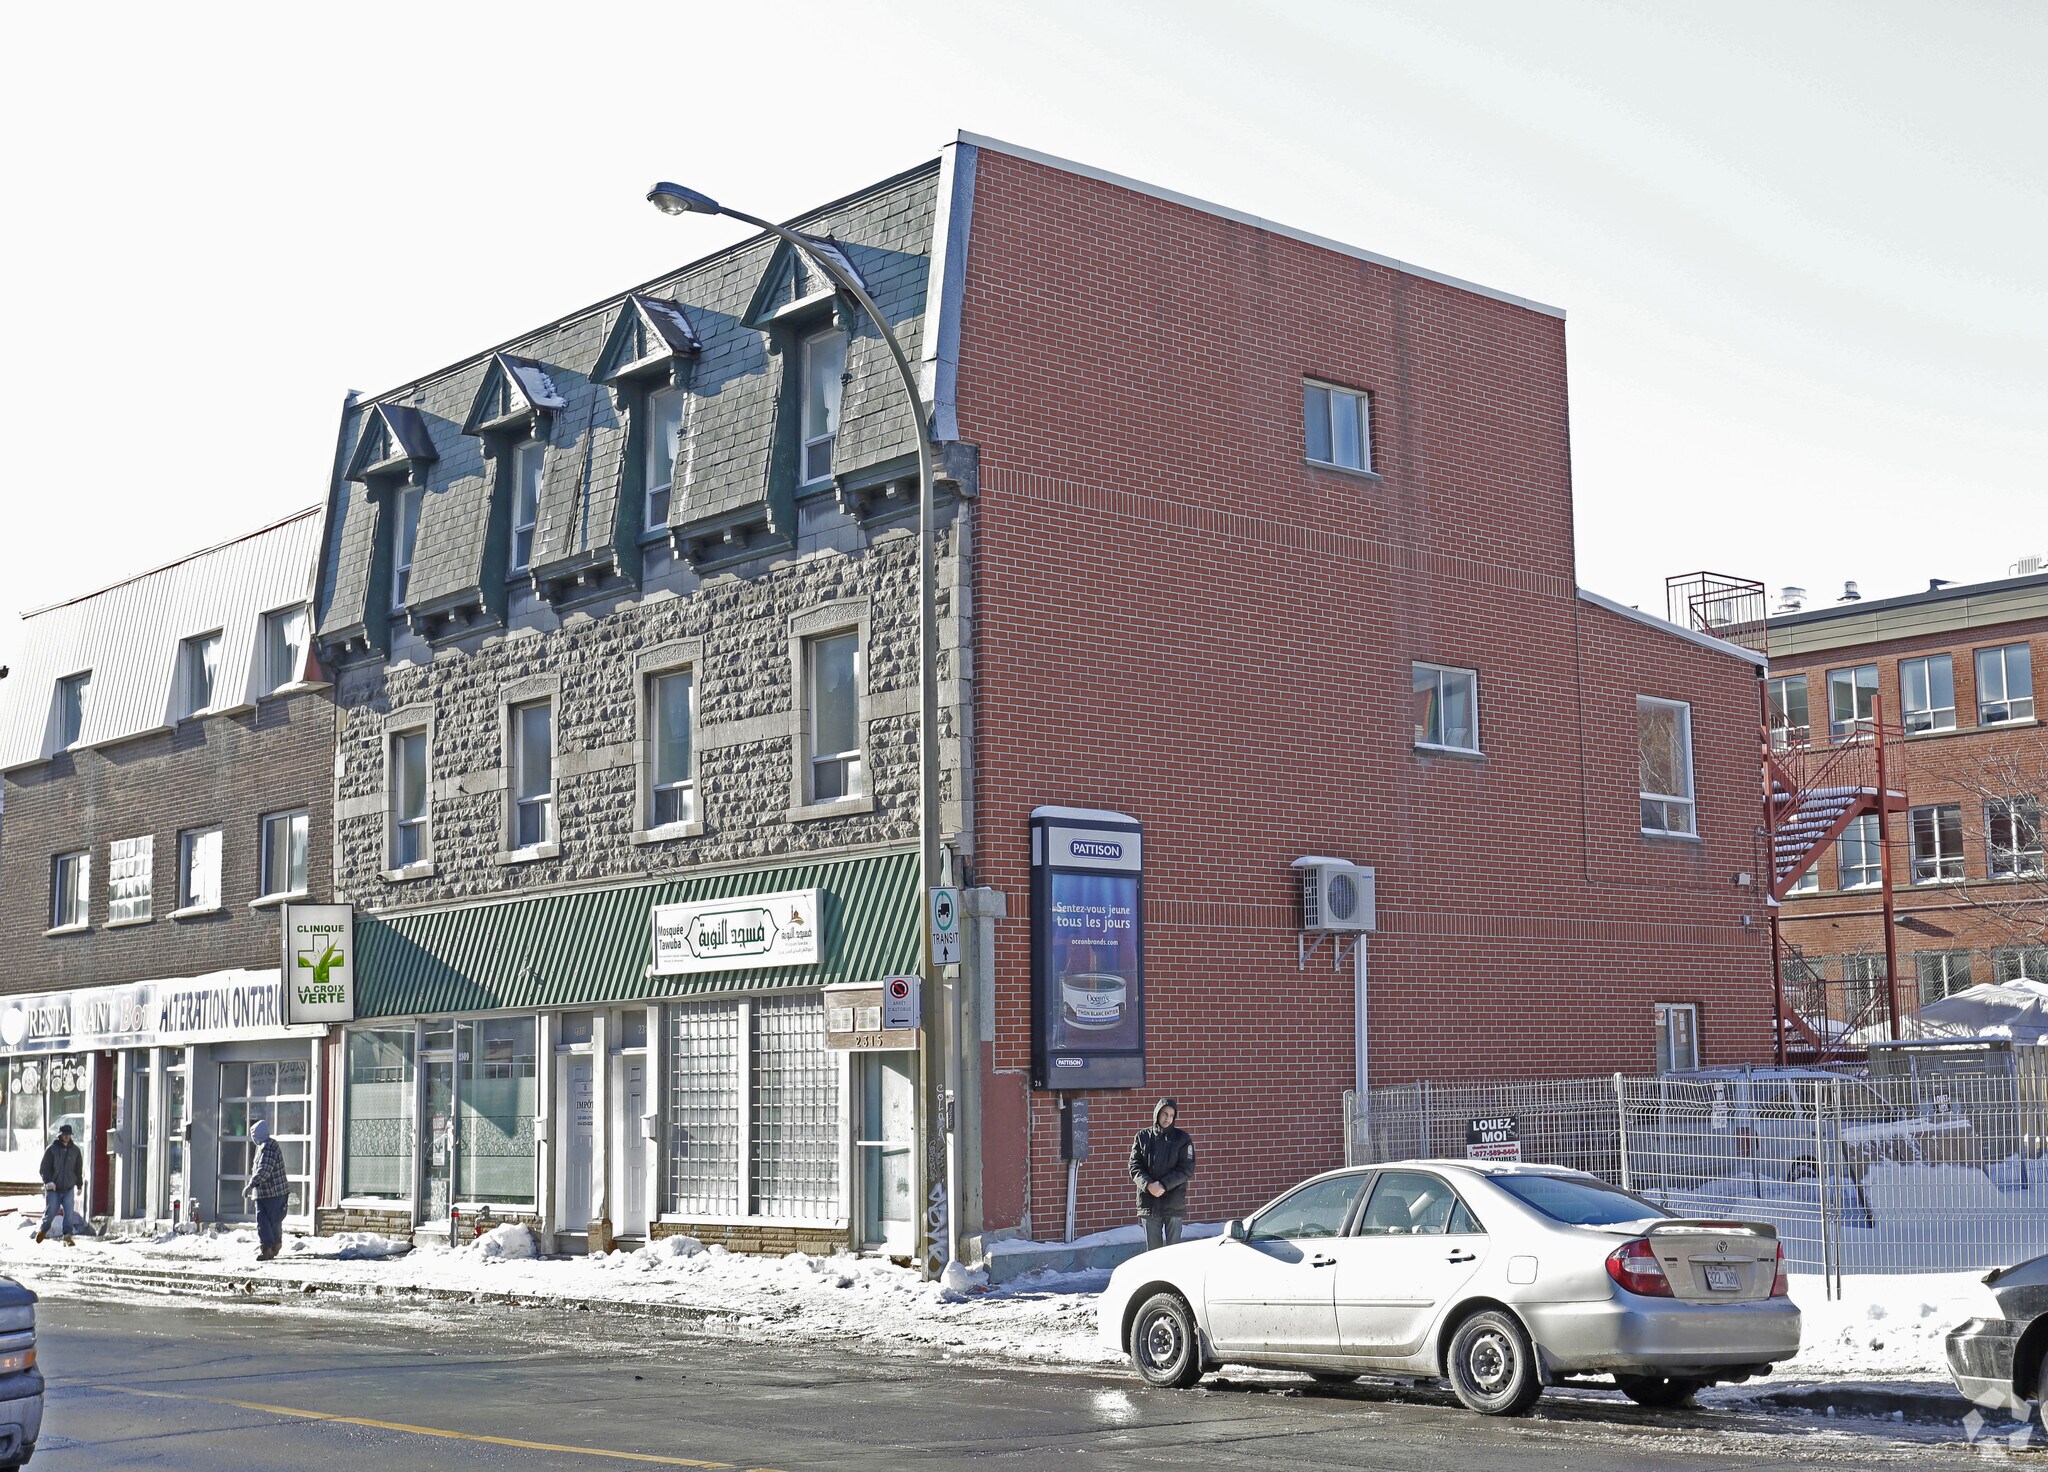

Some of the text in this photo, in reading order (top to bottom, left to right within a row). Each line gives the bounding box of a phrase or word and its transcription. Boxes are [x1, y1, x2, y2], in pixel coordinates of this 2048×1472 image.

[1073, 843, 1119, 856] PATTISON
[1056, 902, 1130, 917] Sentez-vous jeune
[297, 925, 344, 933] CLINIQUE
[1056, 914, 1130, 933] tous les jours
[658, 923, 684, 938] Mosquée
[699, 918, 765, 950] مسجد التوبة
[659, 938, 681, 950] Tawuba
[932, 932, 959, 945] TRANSIT
[1071, 938, 1119, 946] oceanbrands.com
[298, 985, 345, 994] LA CROIX
[298, 993, 345, 1004] VERTE
[159, 989, 229, 1032] ALTERATION
[855, 1034, 884, 1047] 2315
[1472, 1118, 1515, 1131] LOUEZ-
[1481, 1131, 1507, 1143] MOI
